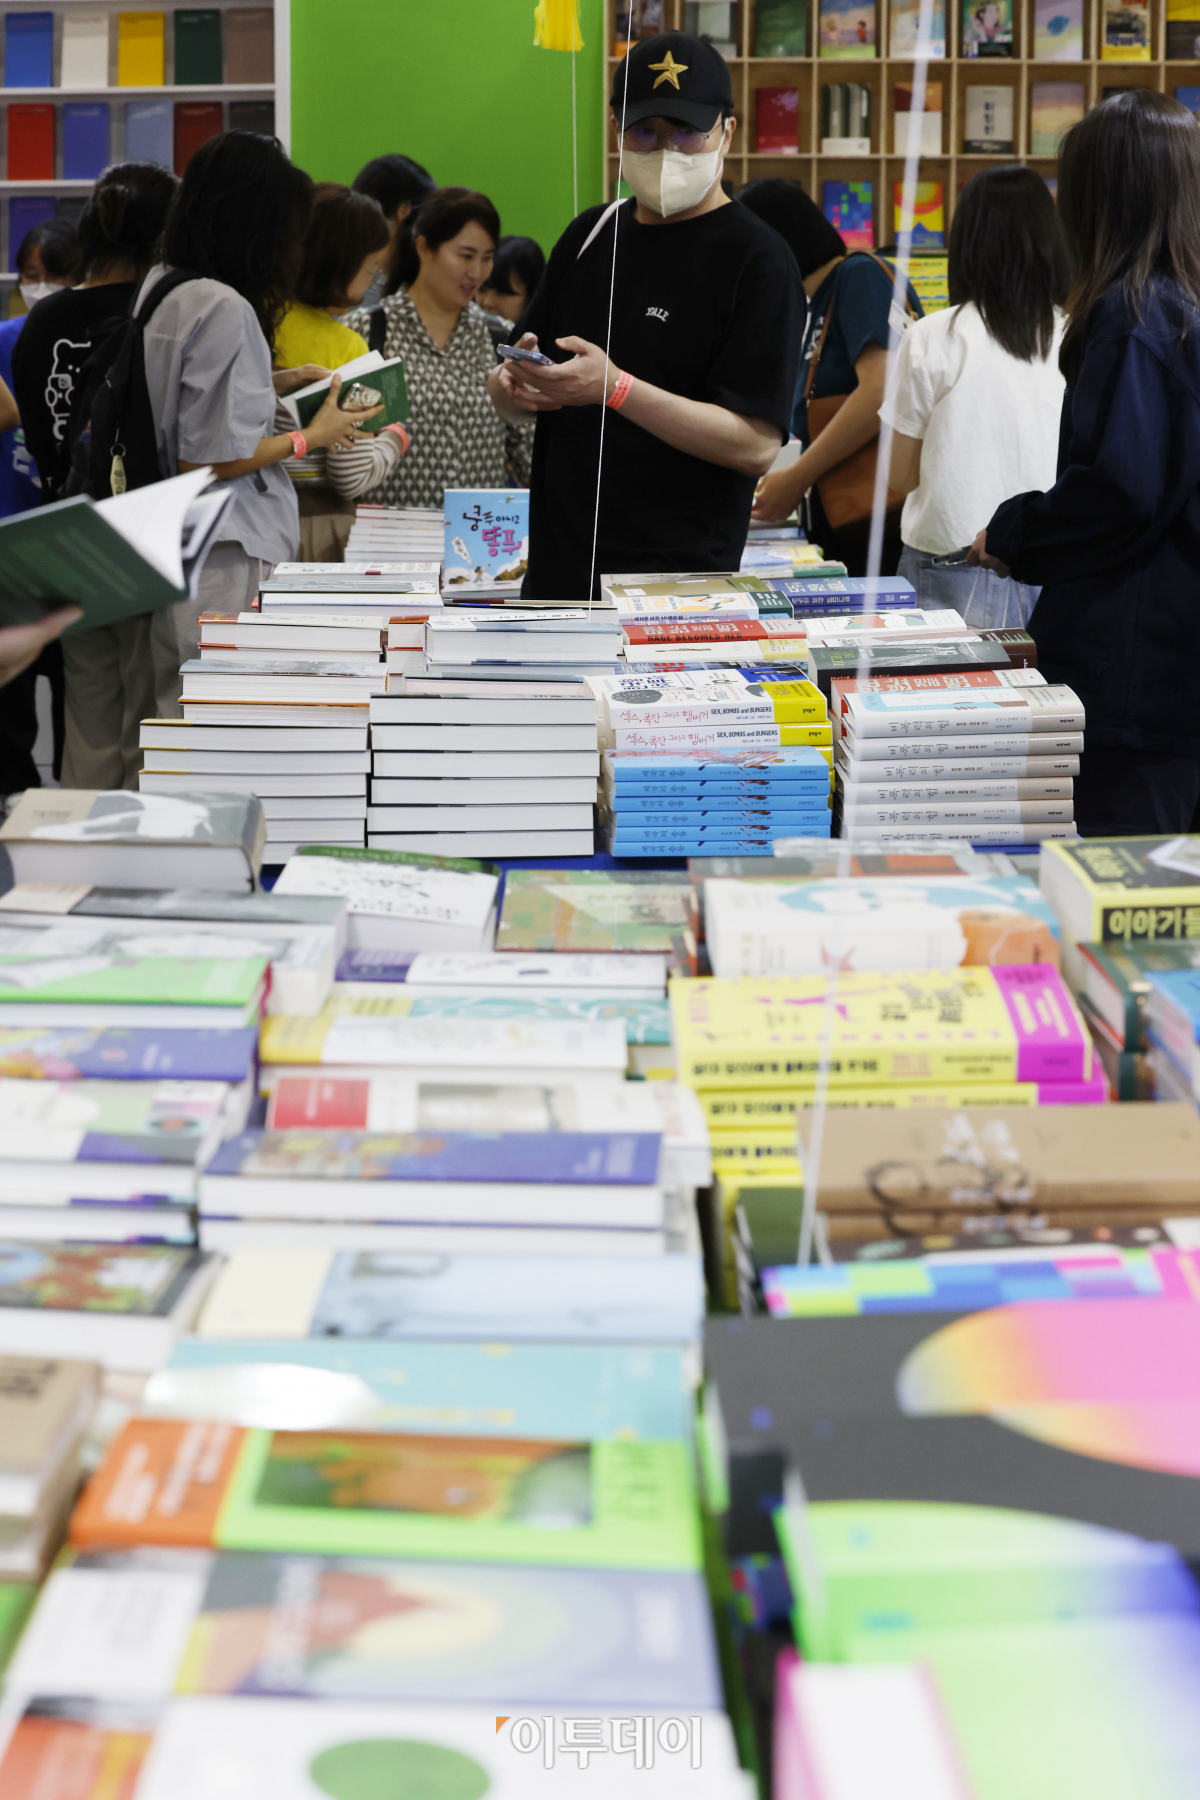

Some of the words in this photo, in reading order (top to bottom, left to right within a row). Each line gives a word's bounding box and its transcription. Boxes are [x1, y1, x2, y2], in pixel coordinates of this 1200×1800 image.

[646, 306, 669, 322] YALE
[463, 504, 494, 531] 쿵푸
[496, 516, 520, 524] 아니고
[482, 526, 522, 556] 똥푸
[620, 710, 642, 723] 섹스,
[643, 712, 660, 725] 폭탄
[681, 710, 708, 722] 햄버거
[889, 720, 935, 733] 비폭력의
[937, 720, 949, 731] 힘
[626, 733, 648, 746] 섹스,
[649, 735, 666, 748] 폭탄
[688, 733, 714, 745] 햄버거
[888, 744, 934, 756] 비폭력의
[936, 744, 948, 754] 힘
[884, 766, 930, 778] 비폭력의
[932, 766, 944, 776] 힘
[878, 788, 923, 800] 비폭력의
[926, 788, 938, 800] 힘
[877, 810, 923, 823] 비폭력의
[926, 811, 938, 822] 힘
